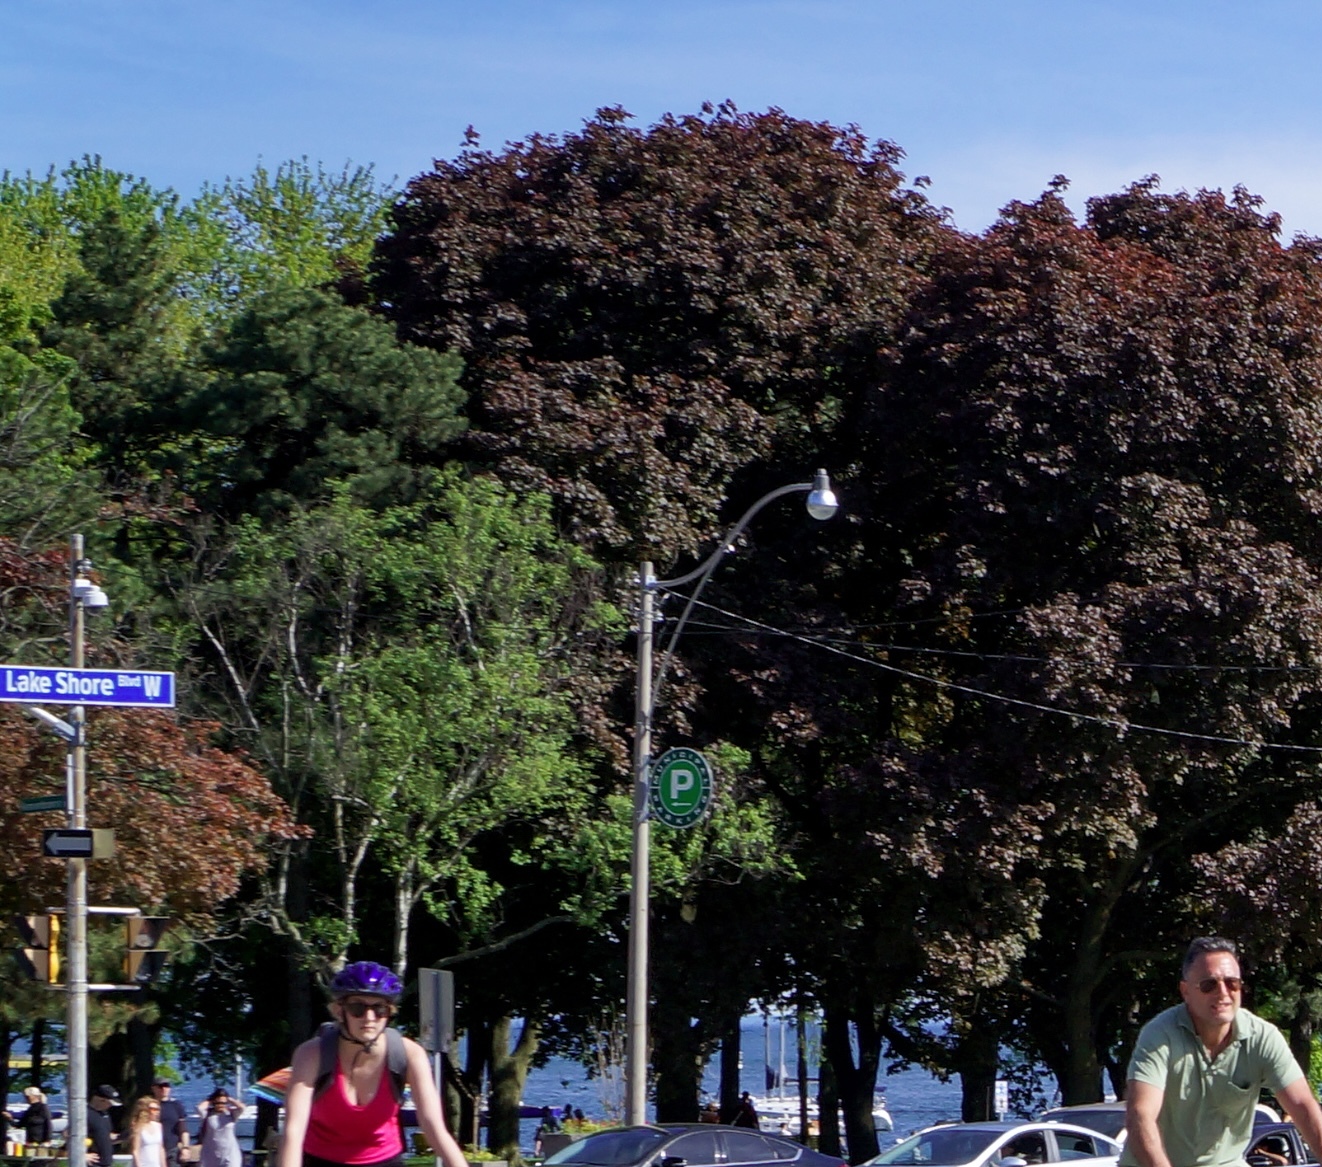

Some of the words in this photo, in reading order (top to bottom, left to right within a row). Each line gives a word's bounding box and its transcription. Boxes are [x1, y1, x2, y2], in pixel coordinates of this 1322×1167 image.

[6, 670, 52, 694] Lake
[55, 671, 115, 696] Shore
[117, 674, 141, 687] Blvd
[143, 675, 162, 698] W
[670, 769, 694, 800] P
